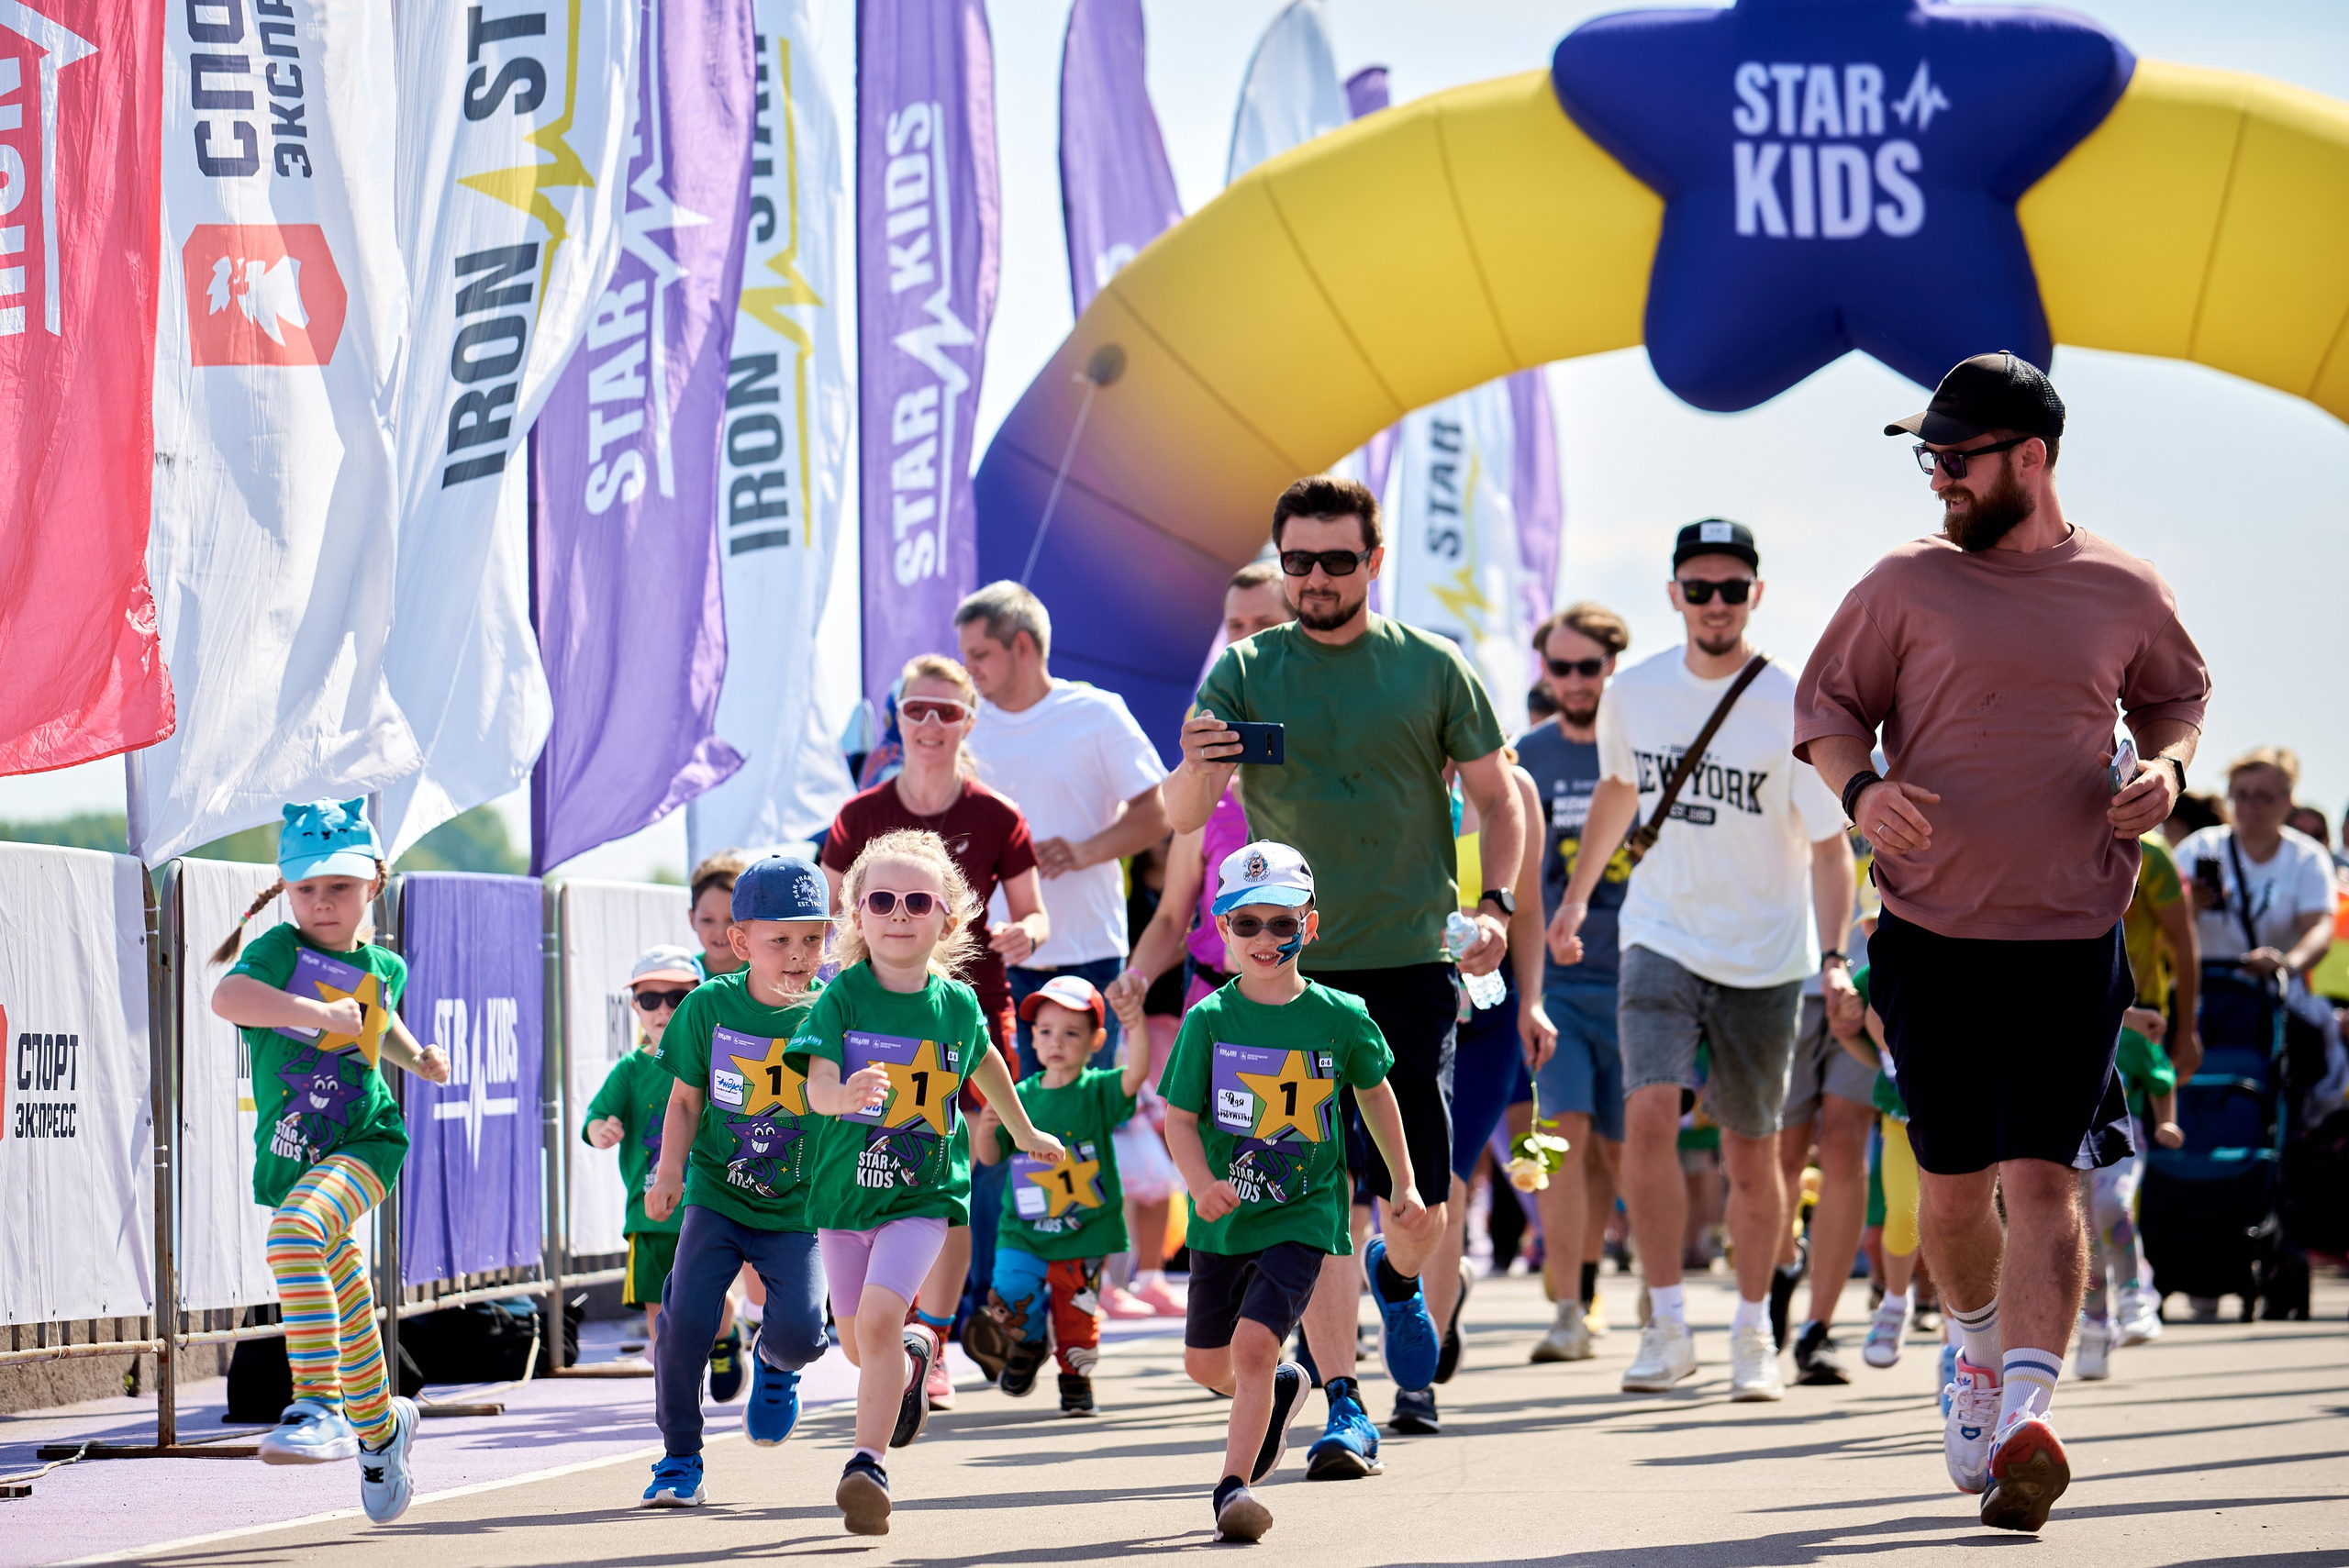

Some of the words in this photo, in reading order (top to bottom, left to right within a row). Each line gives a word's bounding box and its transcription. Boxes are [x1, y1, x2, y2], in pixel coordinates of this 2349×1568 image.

[1733, 61, 1885, 137] STAR
[885, 102, 933, 294] KIDS
[1732, 140, 1925, 239] KIDS
[441, 242, 540, 490] IRON
[584, 278, 647, 515] STAR
[728, 352, 791, 557] IRON
[894, 384, 939, 586] STAR
[1691, 762, 1768, 814] YORK
[17, 1033, 79, 1091] СПОРТ
[765, 1065, 782, 1095] 1
[911, 1072, 929, 1106] 1
[1280, 1082, 1297, 1116] 1
[270, 1134, 303, 1162] KIDS
[275, 1120, 298, 1143] STAR
[856, 1166, 895, 1188] KIDS
[858, 1151, 889, 1170] STAR
[1058, 1169, 1074, 1194] 1
[1229, 1162, 1254, 1183] STAR
